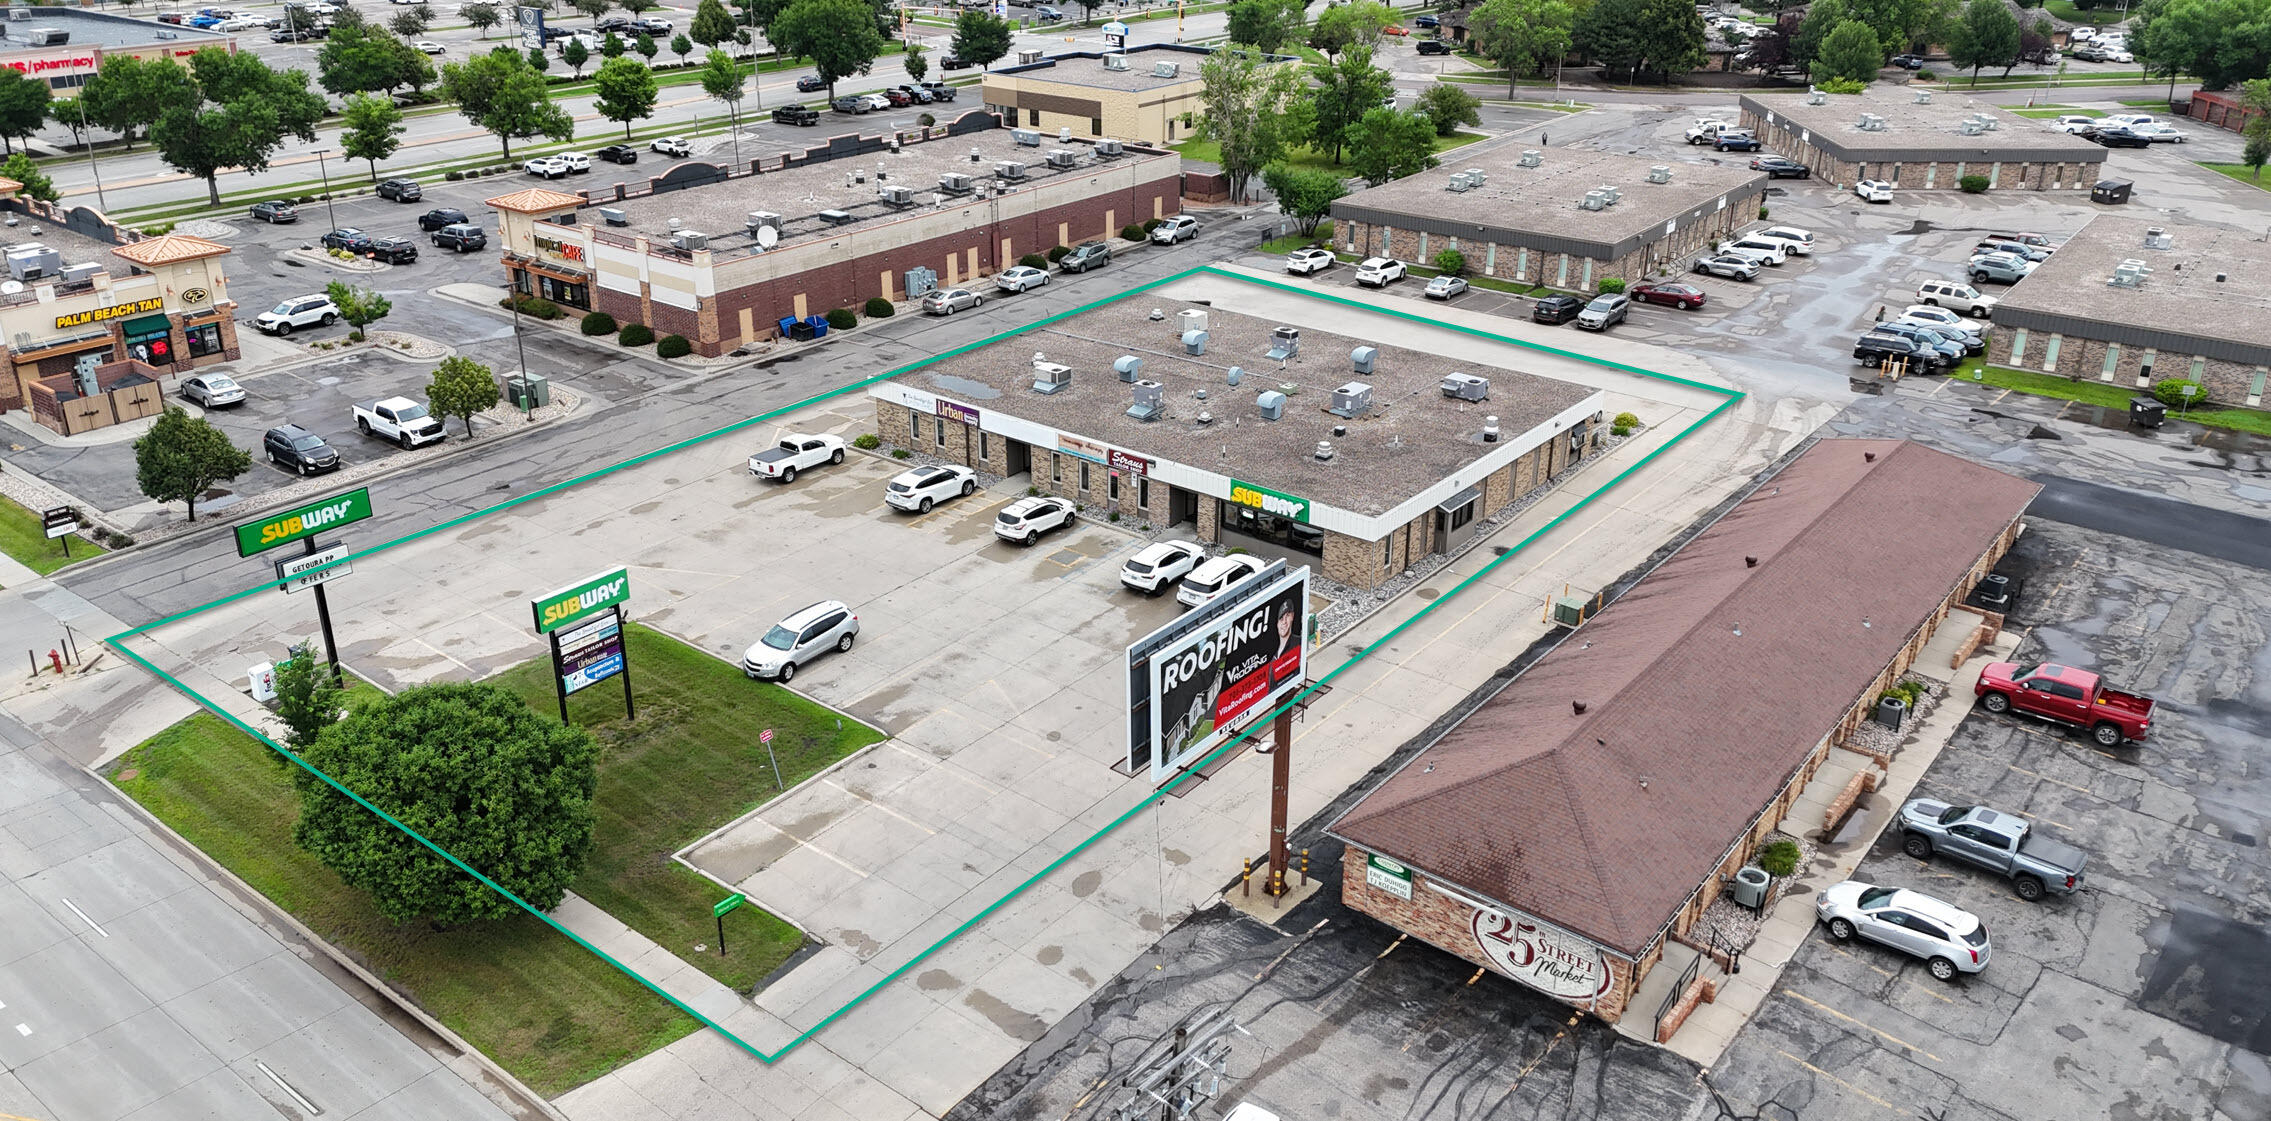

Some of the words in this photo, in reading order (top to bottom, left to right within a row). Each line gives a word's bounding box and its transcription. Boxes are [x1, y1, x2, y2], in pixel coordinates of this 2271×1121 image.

[562, 243, 583, 261] CAFE
[56, 311, 92, 329] PALM
[94, 303, 136, 321] BEACH
[138, 297, 163, 312] TAN
[937, 400, 964, 421] Urban
[1112, 452, 1144, 469] Straus
[1231, 487, 1304, 518] SUBWAY
[261, 500, 352, 544] SUBWAY
[543, 577, 625, 626] SUBWAY
[577, 655, 597, 669] Urban
[1163, 606, 1271, 695] ROOFING!
[1242, 653, 1259, 668] VITA
[1233, 655, 1268, 682] ROOFING
[1219, 682, 1267, 716] VitaRoofing.com
[1485, 914, 1536, 967] 25
[1538, 938, 1596, 973] STREET
[1534, 957, 1595, 984] Market
